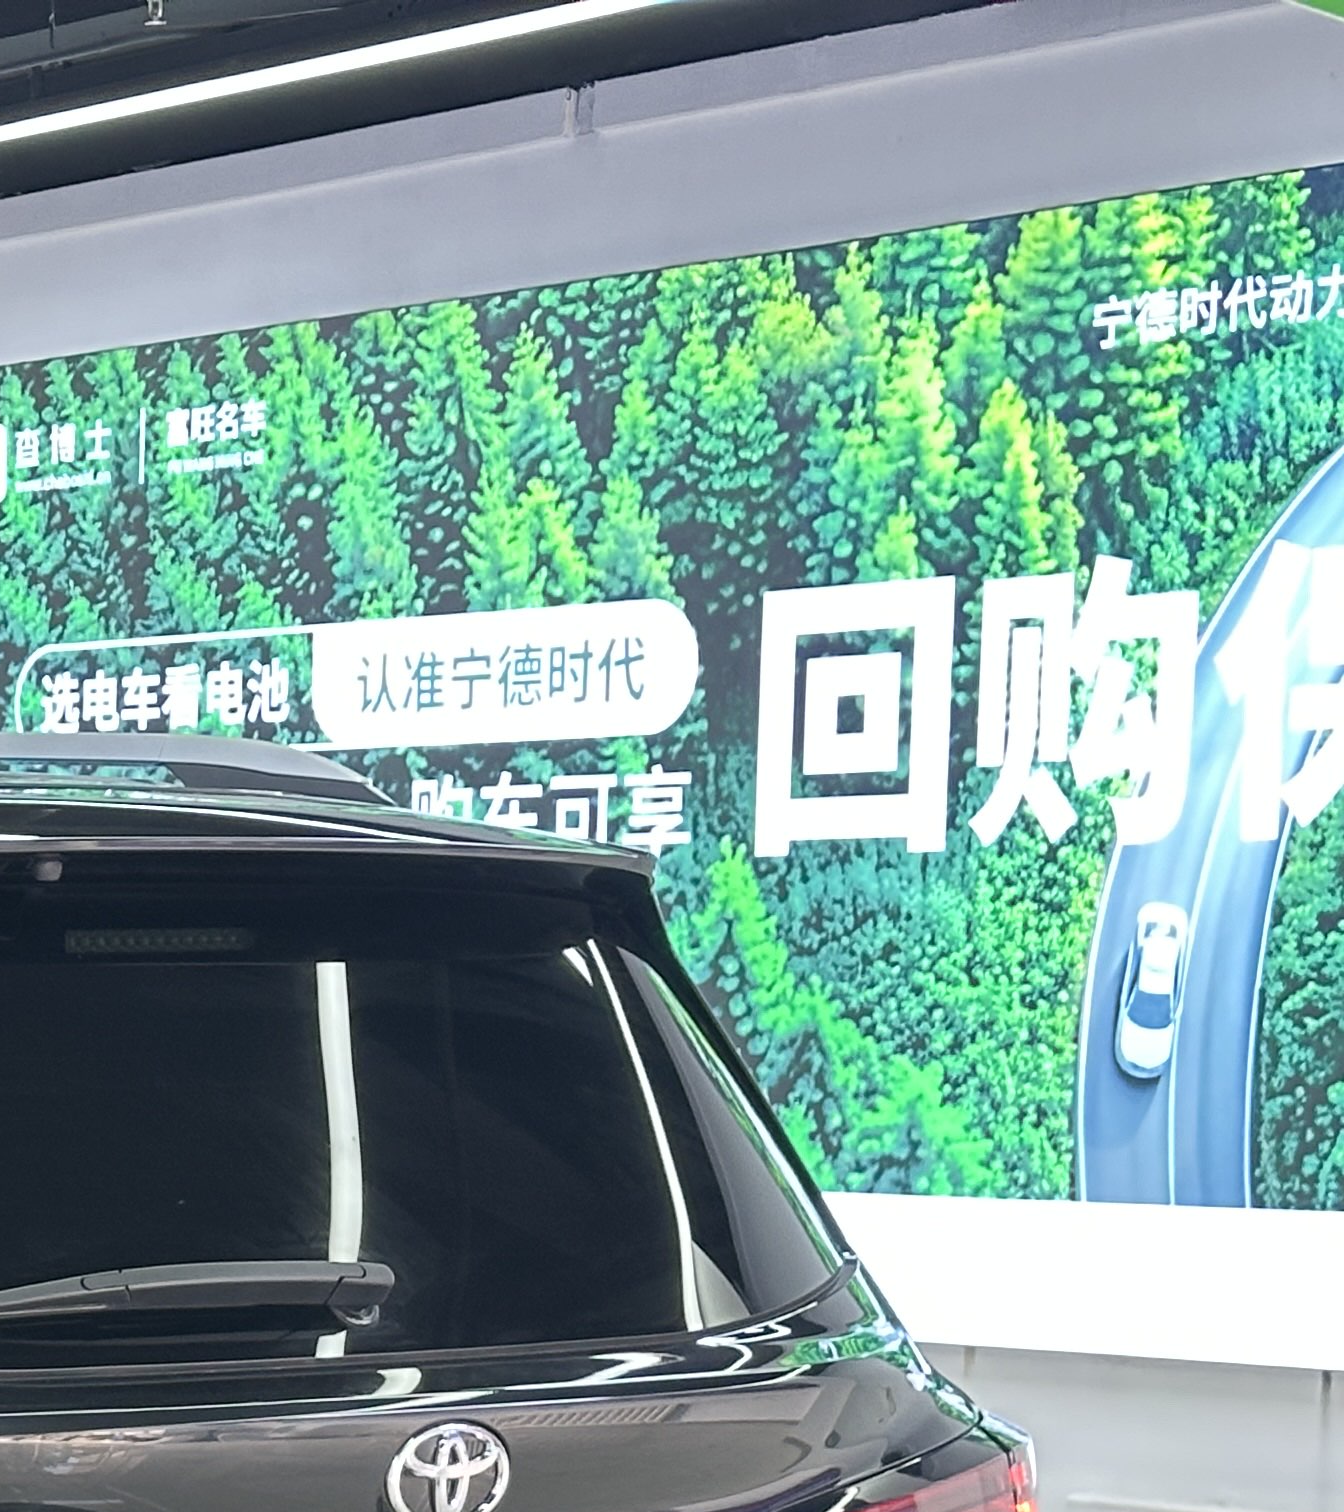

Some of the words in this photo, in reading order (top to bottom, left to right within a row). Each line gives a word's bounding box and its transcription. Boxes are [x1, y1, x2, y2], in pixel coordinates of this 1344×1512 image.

[165, 396, 267, 448] 富旺名车
[40, 658, 290, 734] 选电车看电池
[357, 637, 647, 713] 认准宁德时代
